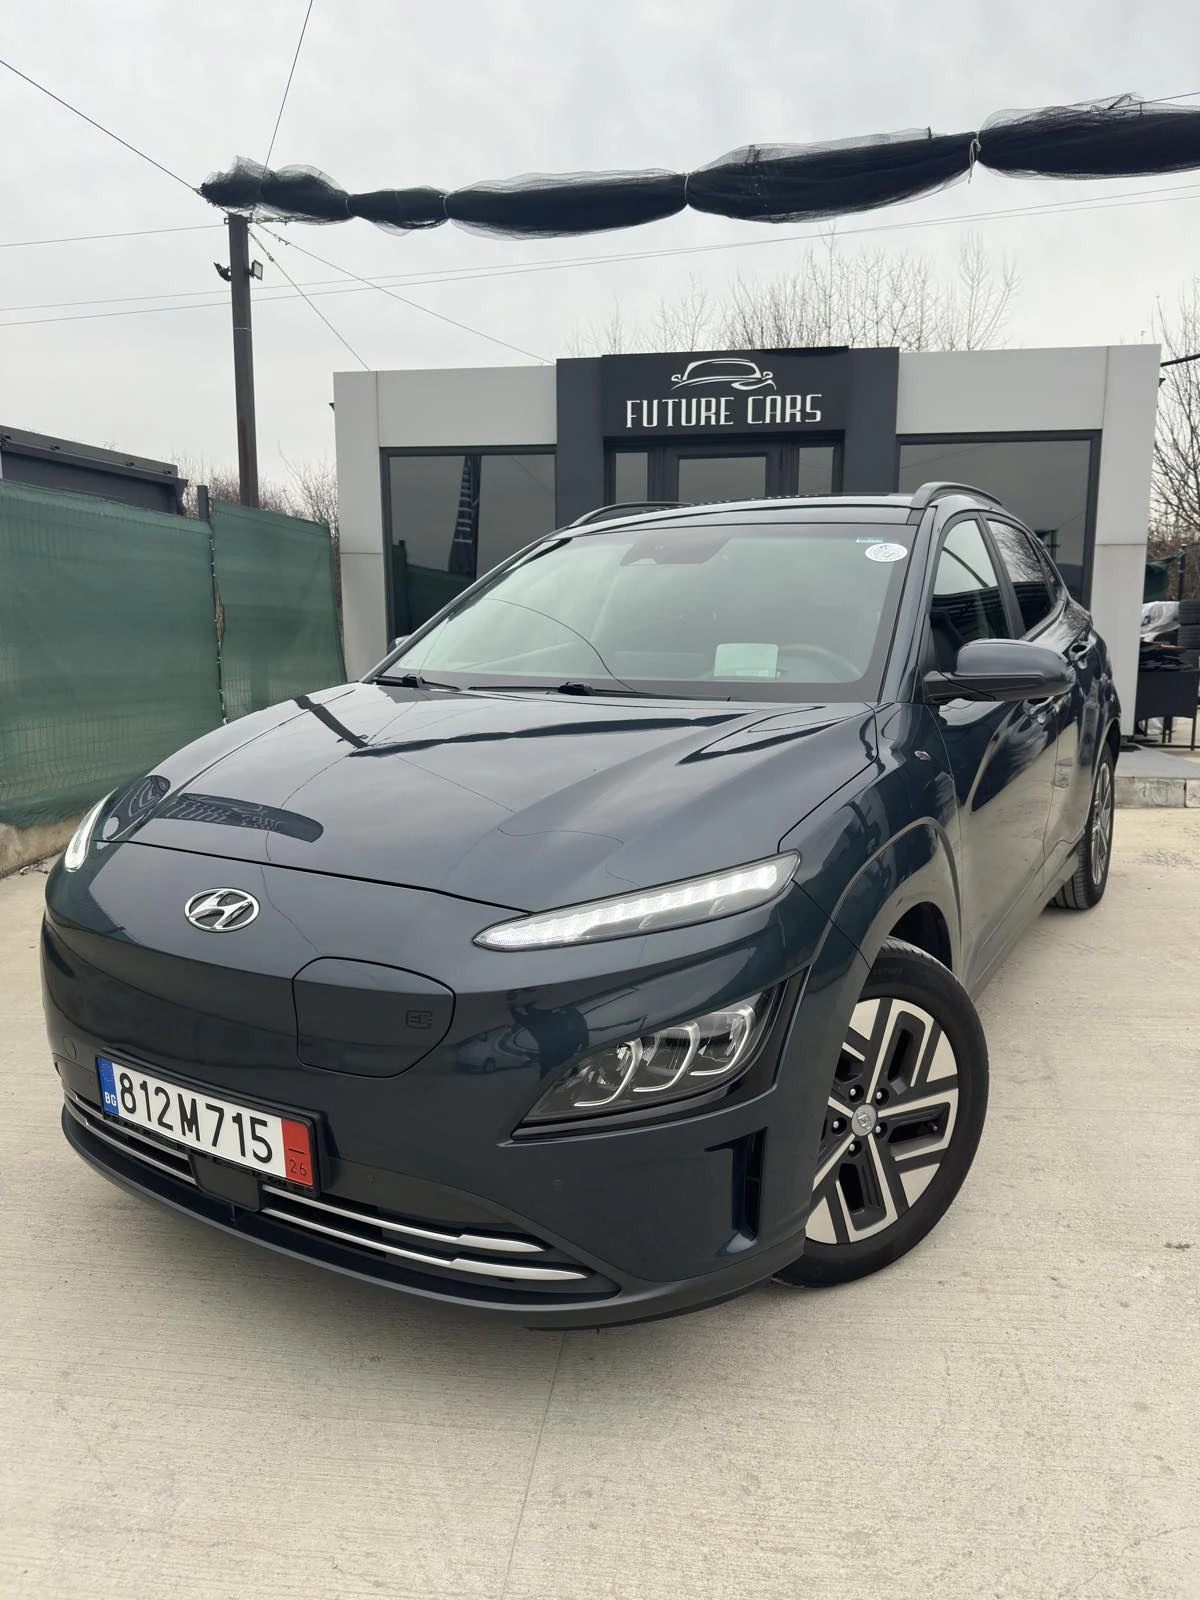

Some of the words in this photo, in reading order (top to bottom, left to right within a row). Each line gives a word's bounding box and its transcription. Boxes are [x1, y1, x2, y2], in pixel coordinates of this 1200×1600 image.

[626, 397, 734, 428] FUTURE
[747, 394, 822, 424] CARS
[104, 1092, 117, 1107] BG
[290, 1159, 307, 1177] 26
